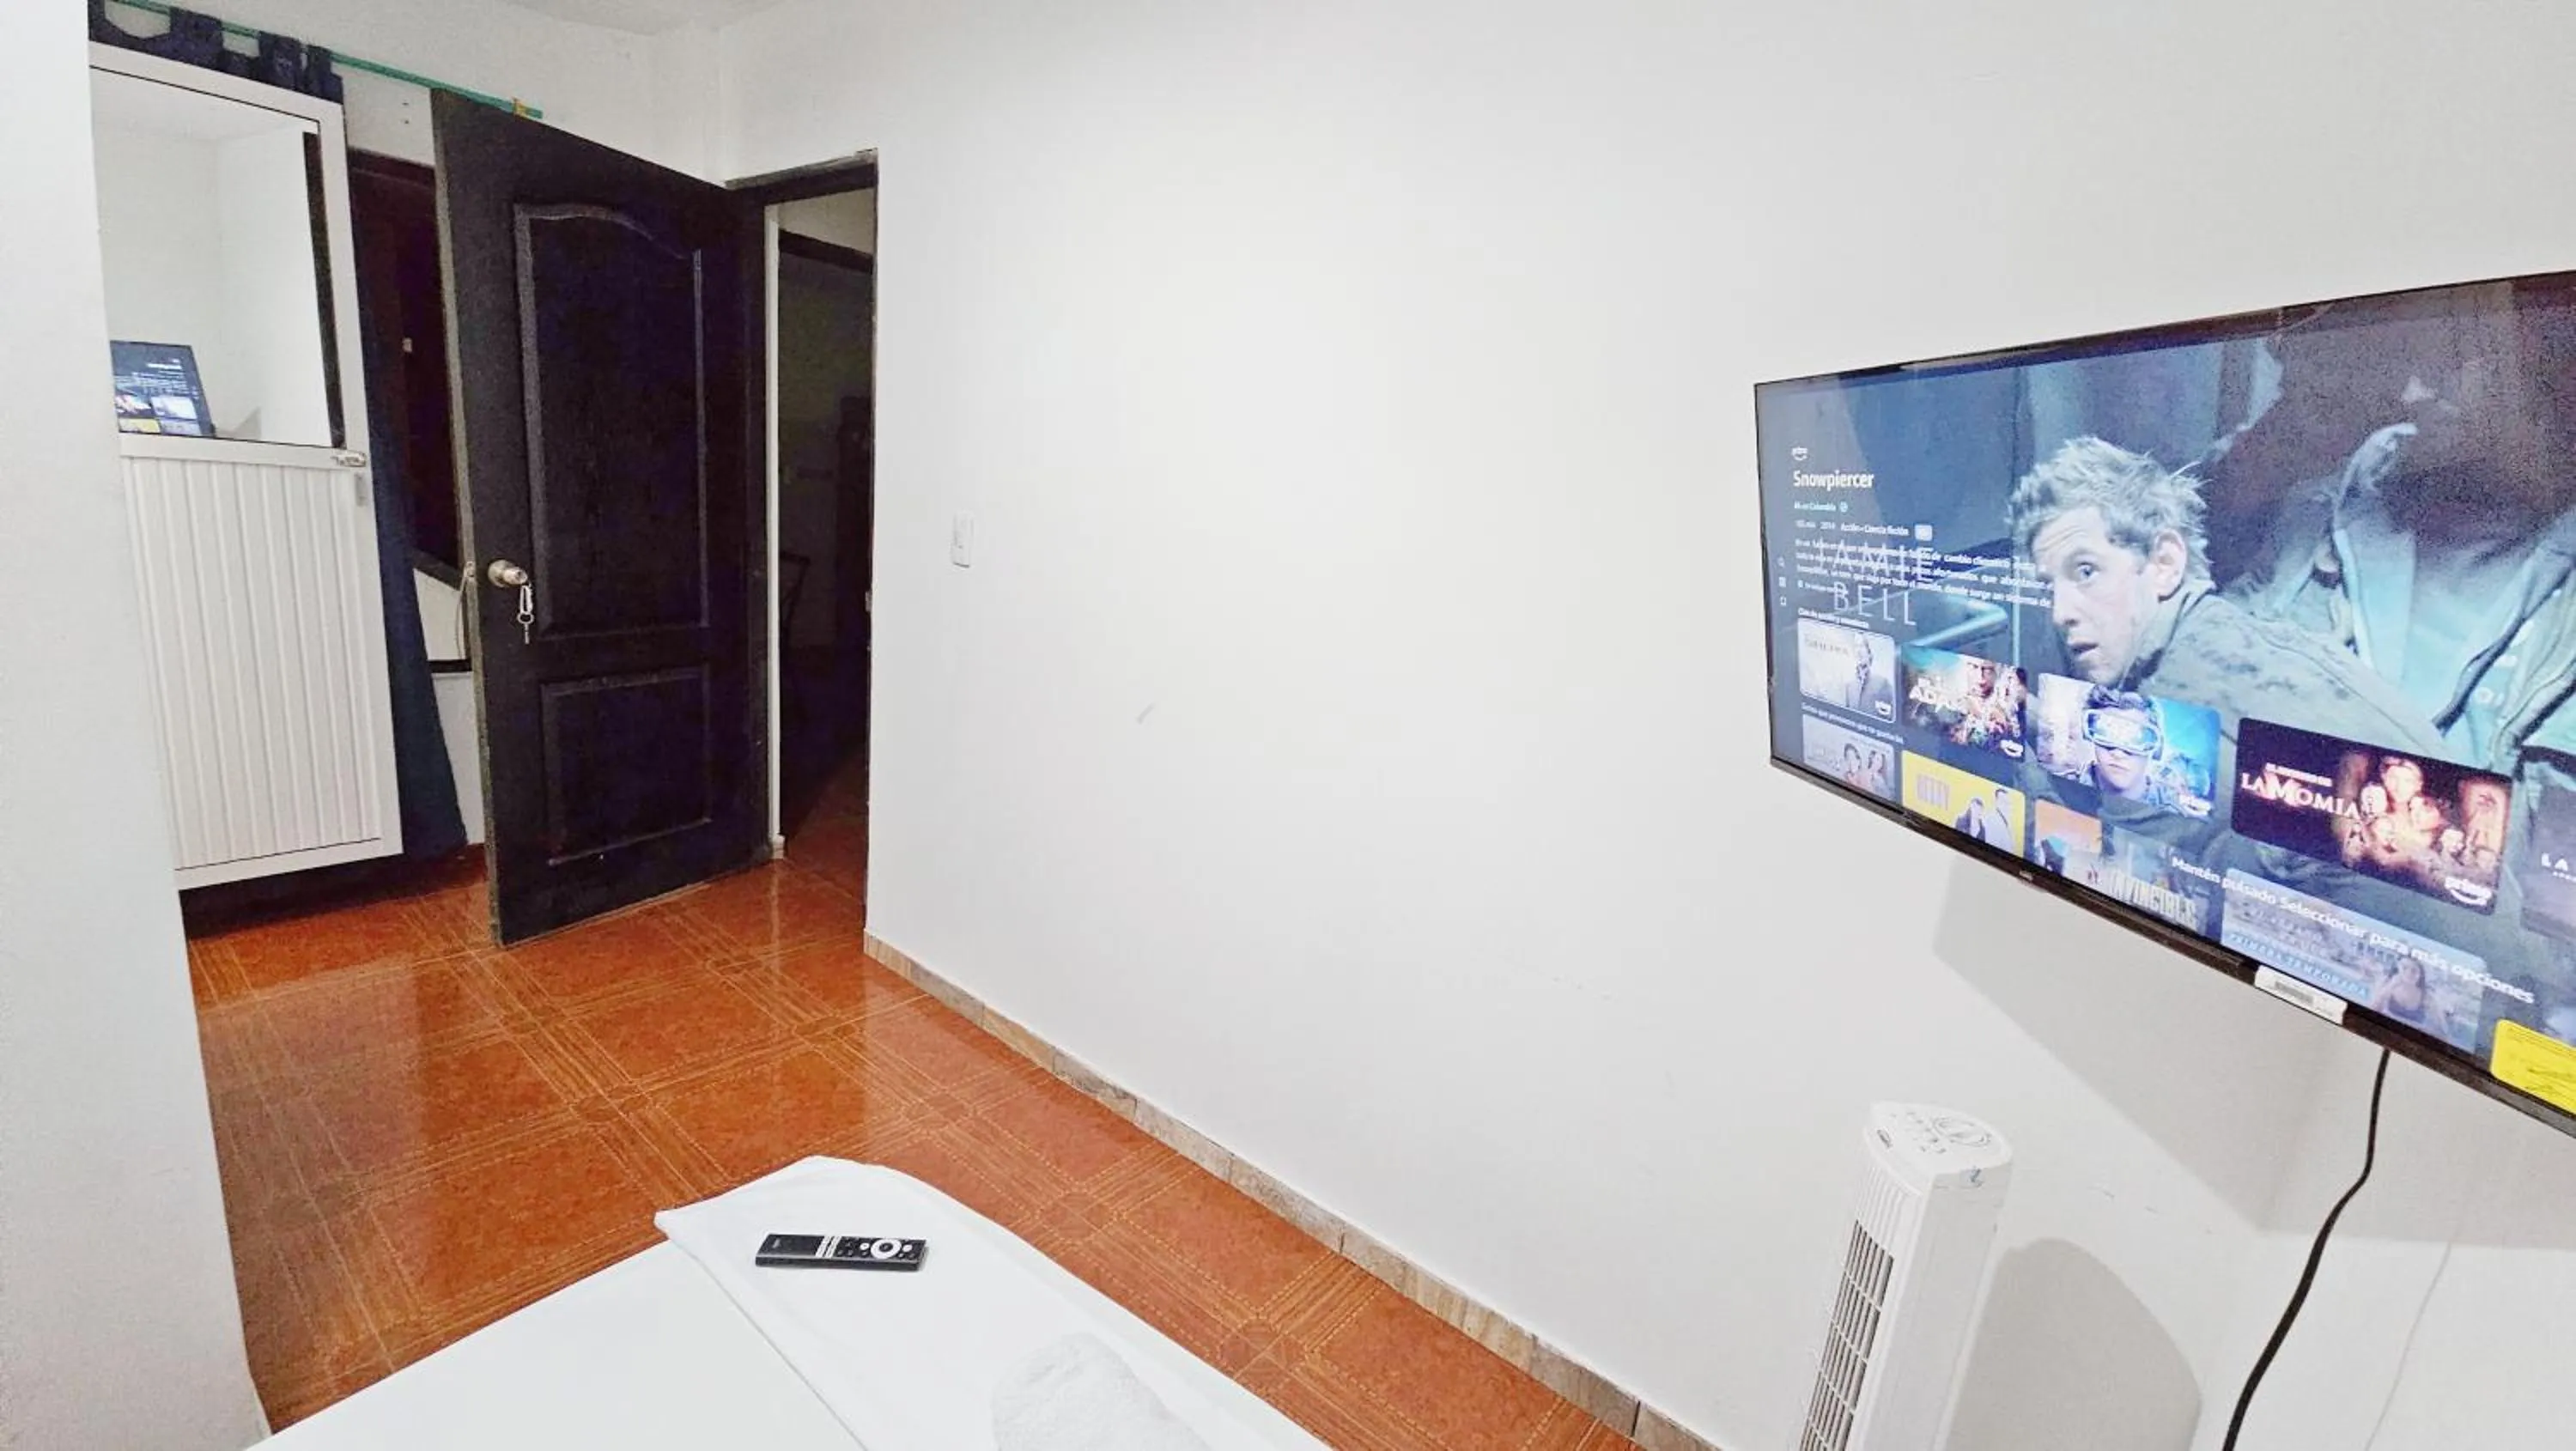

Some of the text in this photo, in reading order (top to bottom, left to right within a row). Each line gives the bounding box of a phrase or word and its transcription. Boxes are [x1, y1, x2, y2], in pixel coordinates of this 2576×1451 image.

[1792, 470, 1874, 491] Snowpiercer
[1833, 581, 1917, 627] BELL
[2241, 773, 2265, 797] LA
[2263, 771, 2361, 819] MOMIA
[2172, 857, 2221, 883] Mantén
[2221, 877, 2276, 904] pulsado
[2280, 897, 2367, 938] Seleccionar
[2369, 932, 2409, 956] para
[2411, 948, 2447, 971] más
[2451, 963, 2534, 1004] opciones
